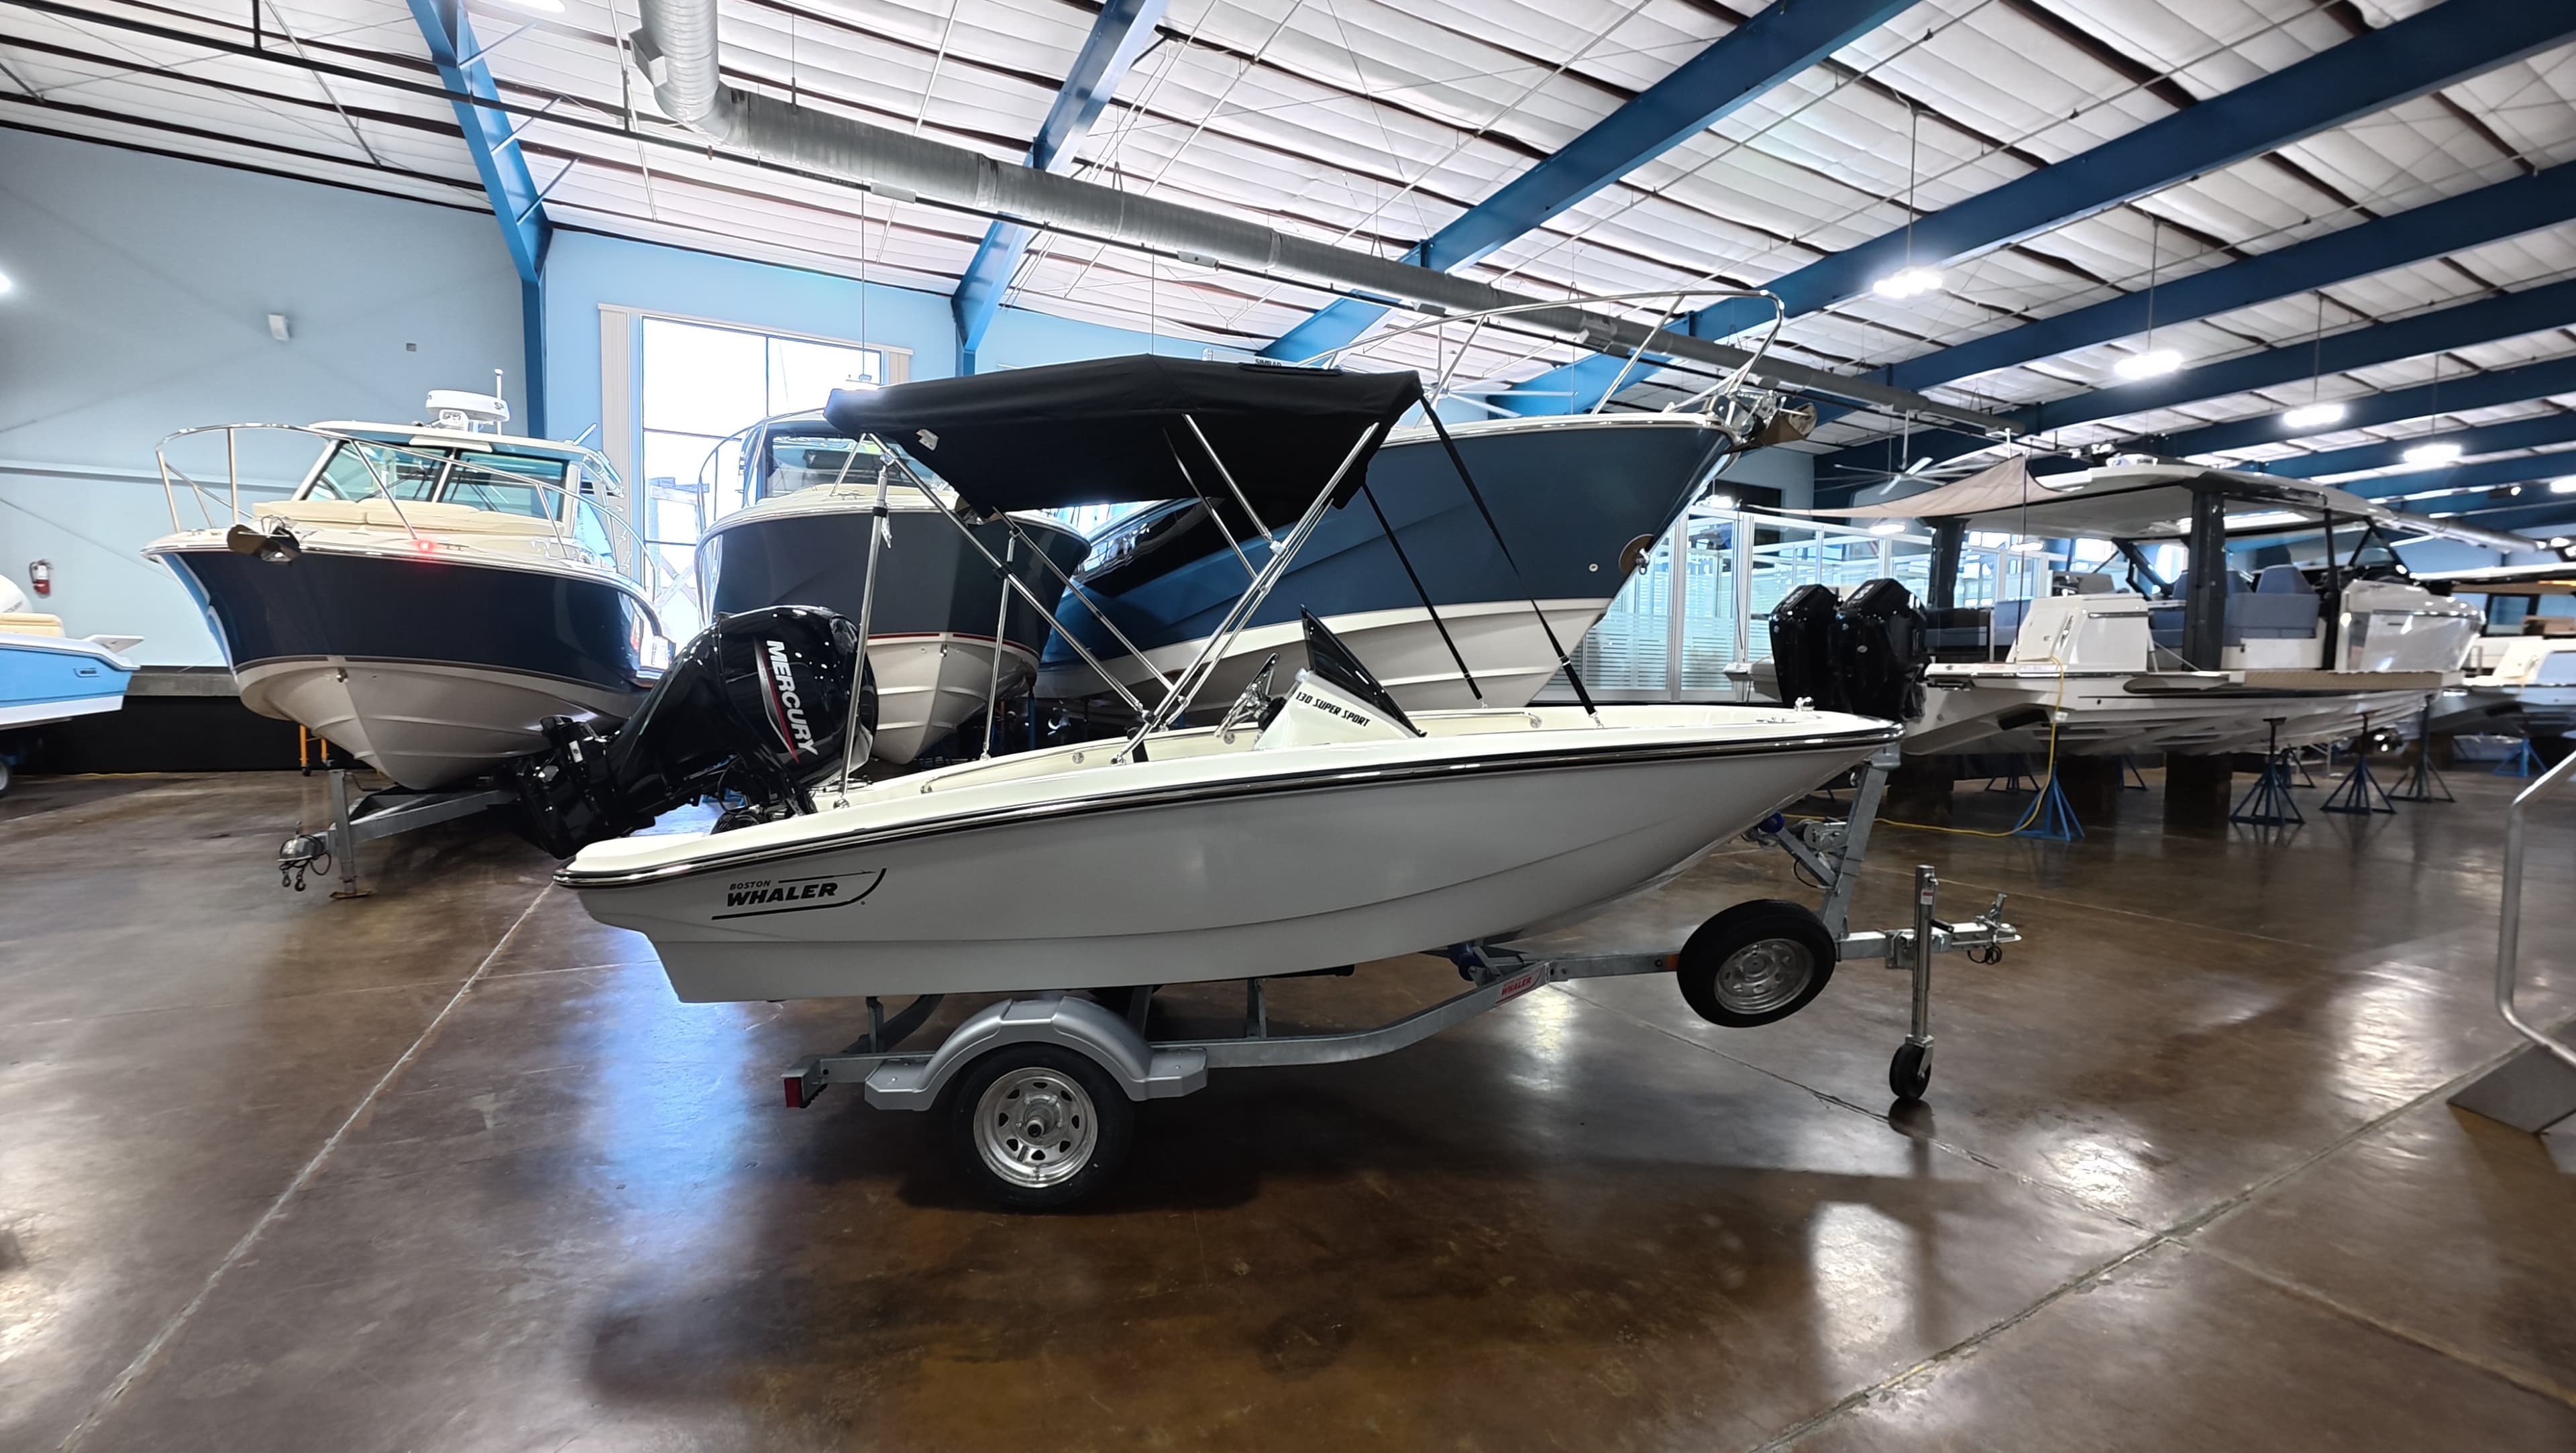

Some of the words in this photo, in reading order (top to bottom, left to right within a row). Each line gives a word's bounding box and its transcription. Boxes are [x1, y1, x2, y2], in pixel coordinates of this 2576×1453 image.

[766, 640, 818, 755] MERCURY
[1295, 692, 1313, 704] 130
[1312, 698, 1342, 716] SUPER
[1341, 710, 1371, 726] SPORT
[727, 882, 839, 906] WHALER
[729, 879, 771, 890] BOSTON
